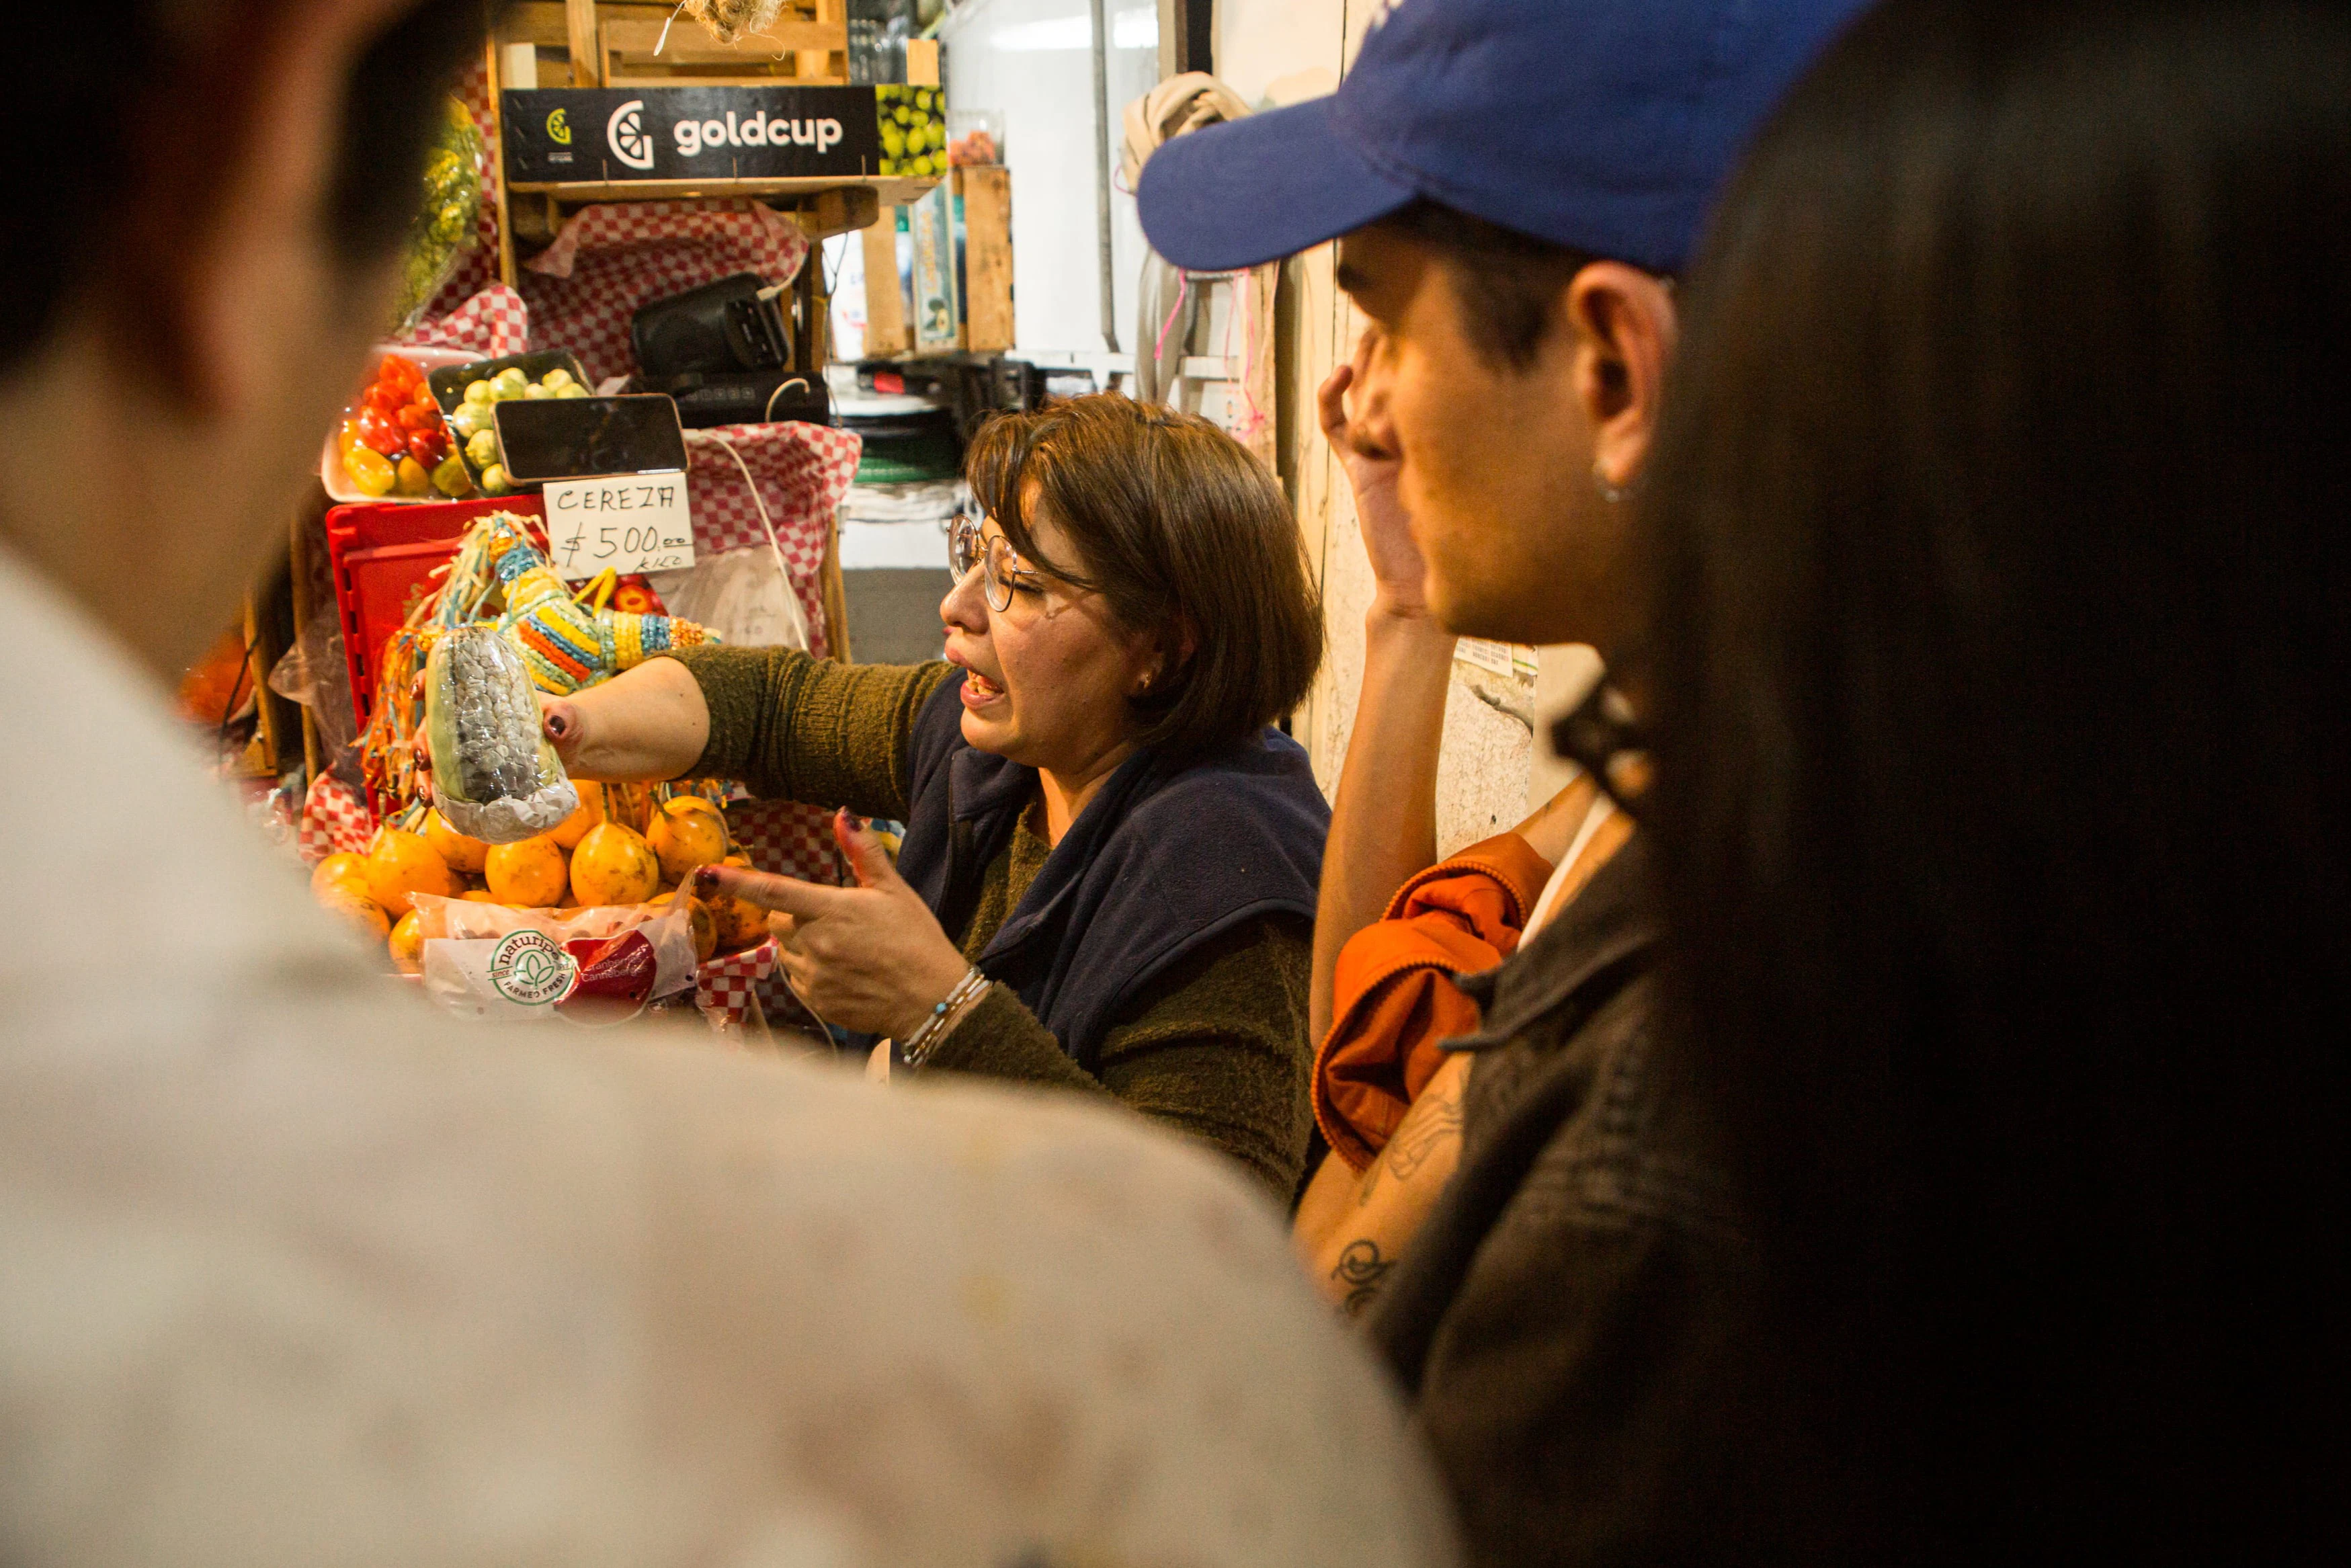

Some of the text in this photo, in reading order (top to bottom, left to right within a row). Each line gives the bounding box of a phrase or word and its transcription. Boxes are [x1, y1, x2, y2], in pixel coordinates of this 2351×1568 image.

[673, 111, 843, 156] goldcup
[557, 486, 674, 511] CEREZA
[499, 936, 560, 965] naturipe
[492, 969, 509, 978] since
[504, 973, 566, 998] FARMED FRESH
